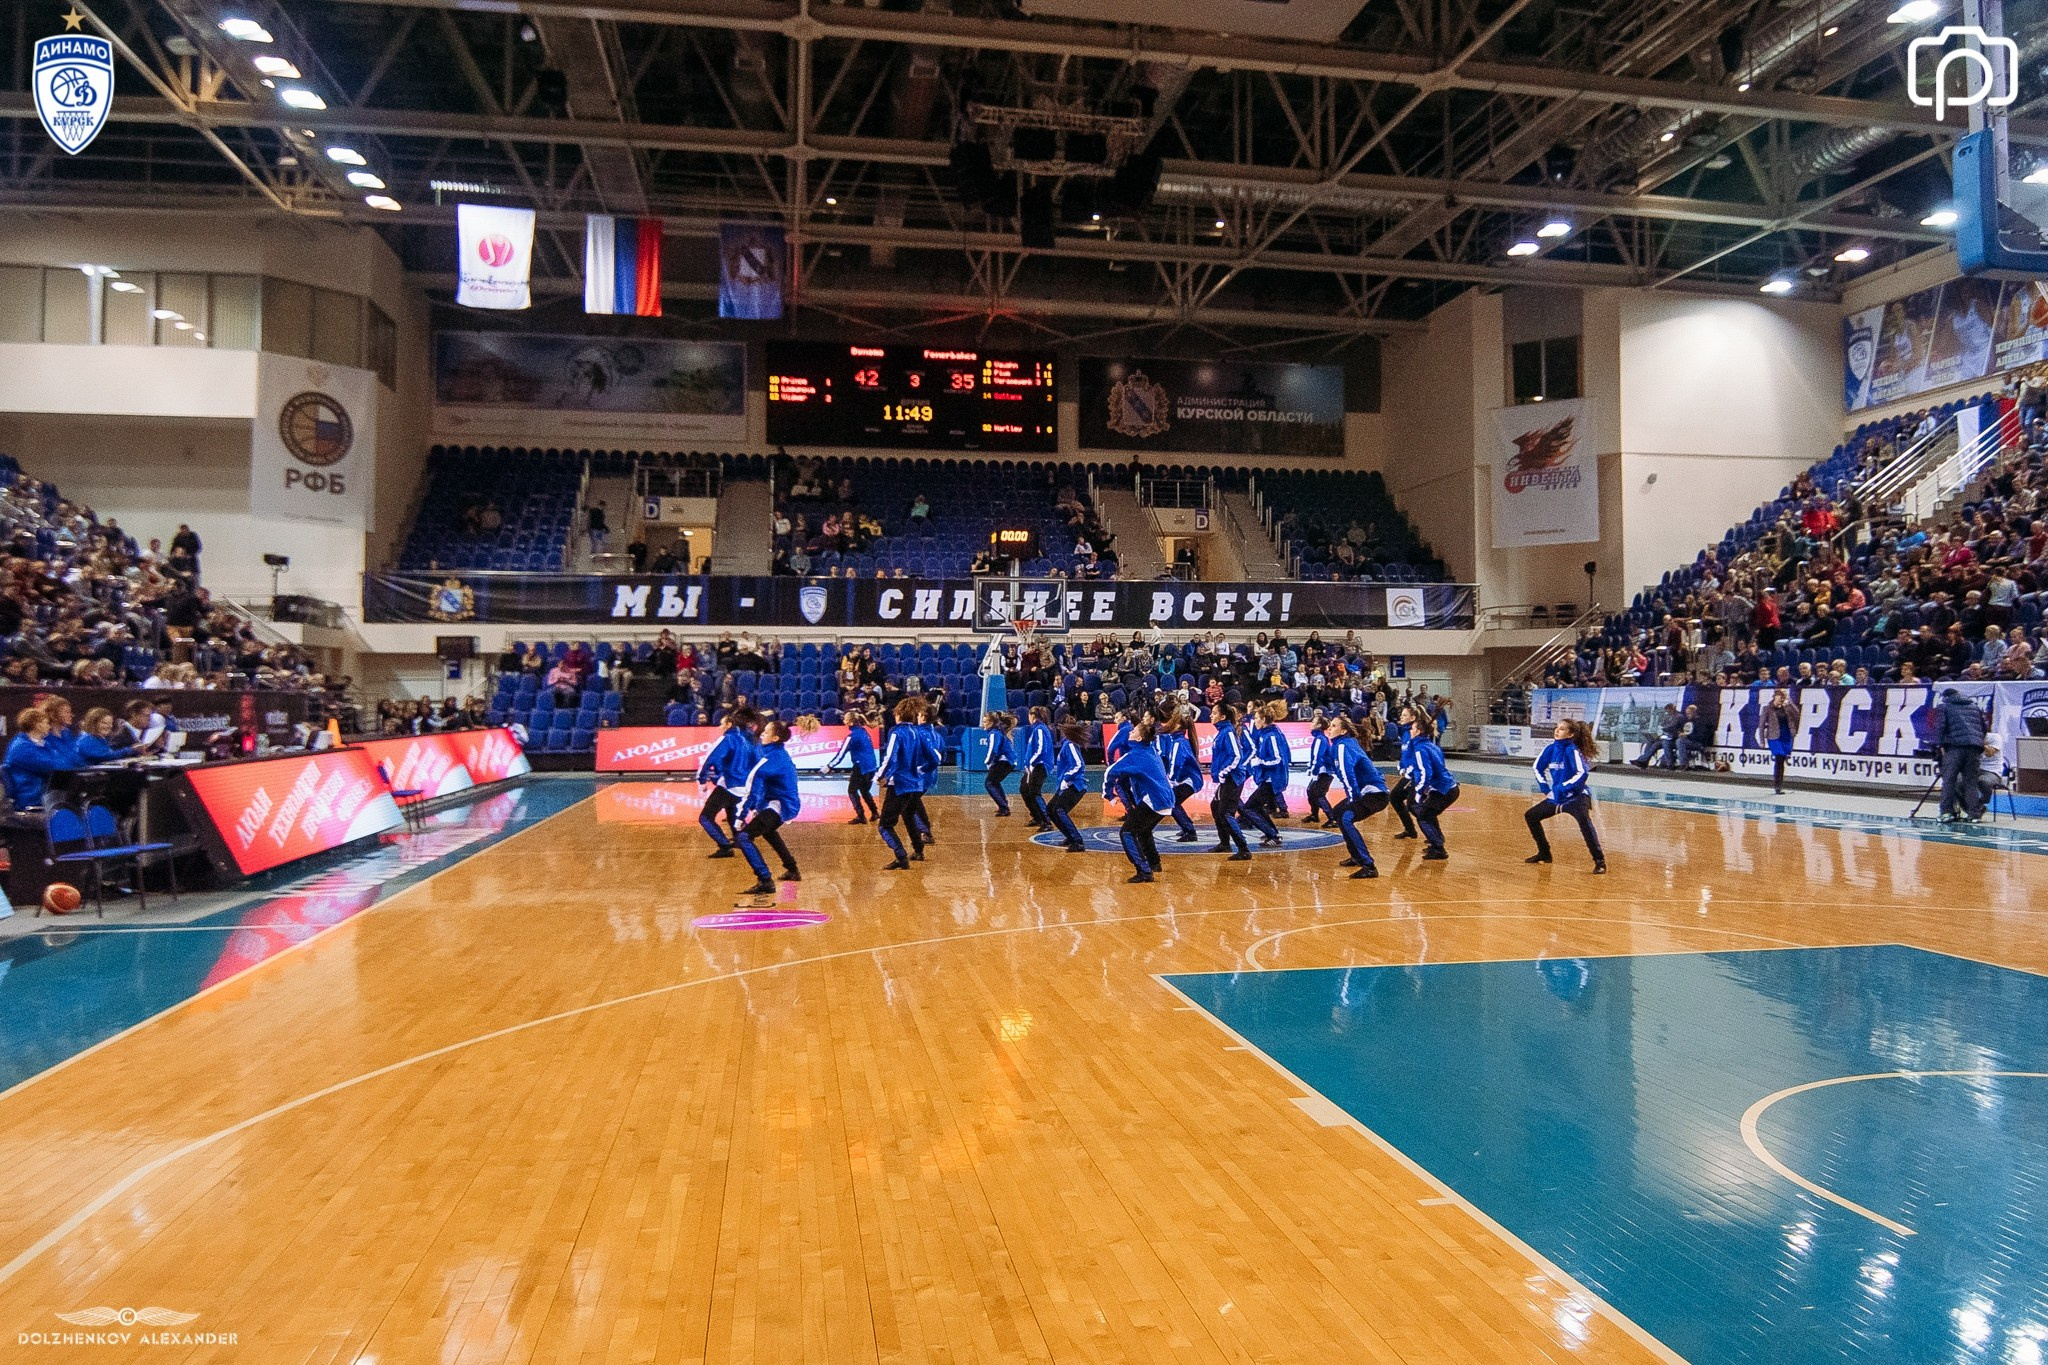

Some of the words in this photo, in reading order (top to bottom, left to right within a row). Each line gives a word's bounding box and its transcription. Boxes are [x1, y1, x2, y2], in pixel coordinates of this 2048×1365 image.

[923, 350, 977, 360] Fenerbahce
[854, 369, 879, 386] 42
[909, 374, 920, 387] 3
[951, 373, 975, 389] 35
[1176, 396, 1266, 408] АДМИНИСТРАЦИЯ
[883, 404, 933, 421] 11:49
[1176, 406, 1244, 421] КУРСКОЙ
[1246, 410, 1314, 424] ОБЛАСТИ
[285, 468, 346, 494] РФБ
[645, 503, 659, 518] D
[1196, 515, 1208, 528] D
[611, 585, 702, 618] МЫ
[878, 588, 1117, 622] СИЛЬНЕЕ
[1151, 591, 1293, 622] ВСЕХ!
[1392, 661, 1403, 677] F
[612, 736, 678, 762] ЛЮДИ
[650, 741, 716, 765] ТЕХНО
[1823, 758, 1892, 778] культуре
[1898, 761, 1908, 774] и
[1914, 762, 1941, 777] спо
[236, 786, 273, 850] ЛЮДИ
